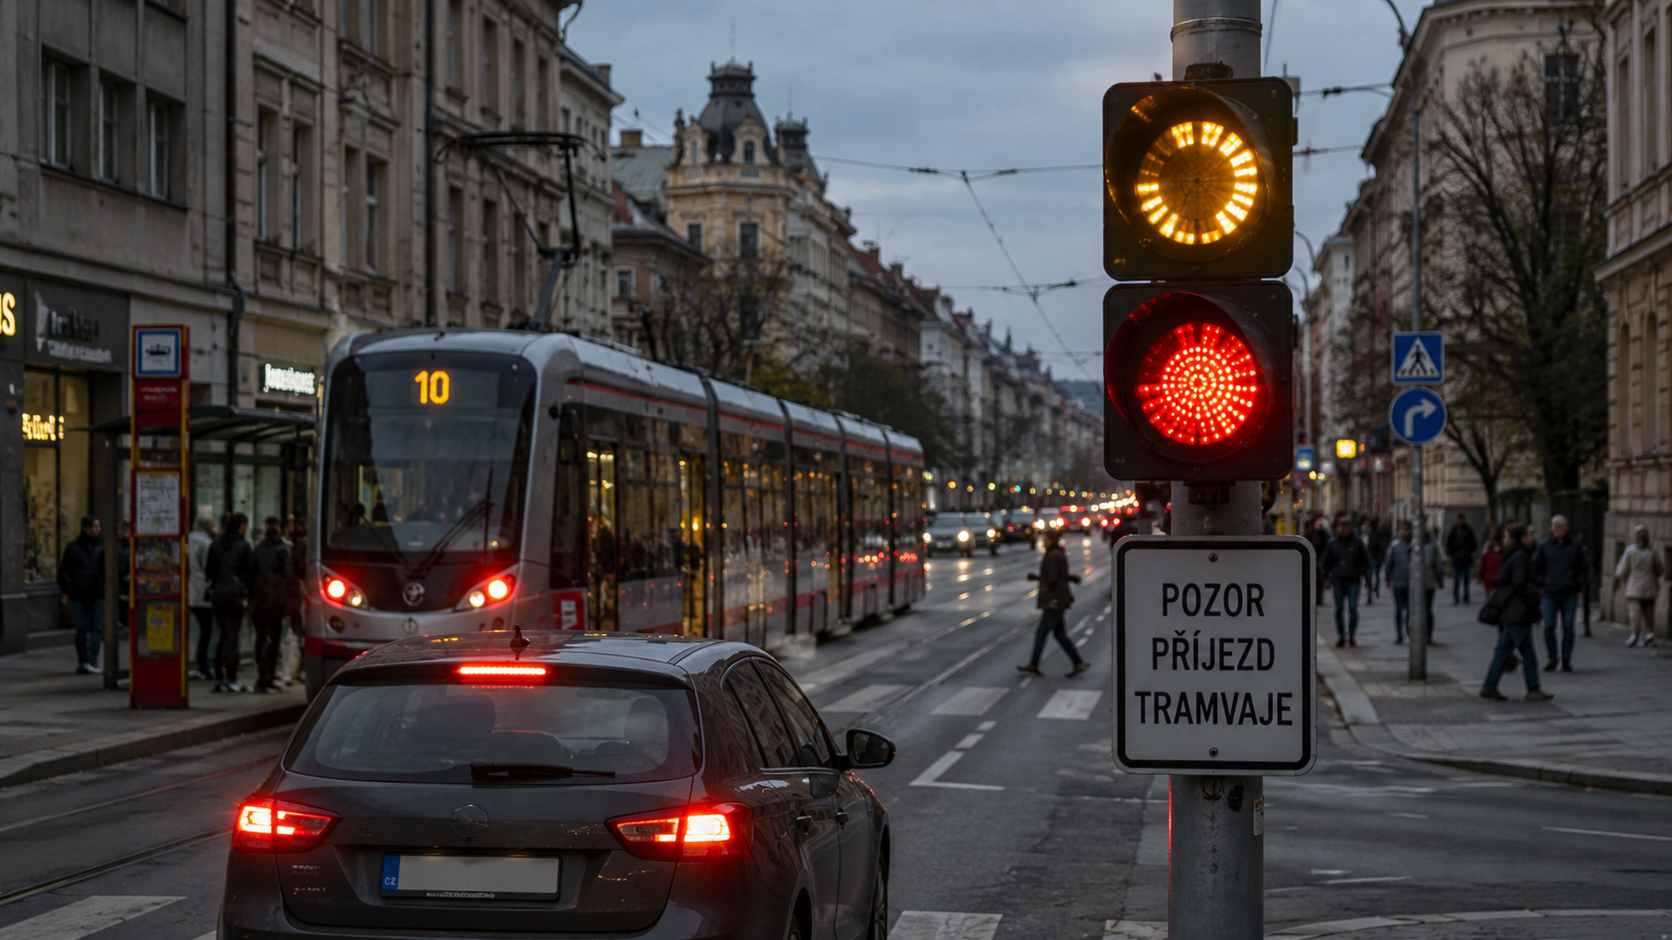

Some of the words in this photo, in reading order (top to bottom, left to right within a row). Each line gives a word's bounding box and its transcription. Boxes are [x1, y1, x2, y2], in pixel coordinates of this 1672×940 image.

[415, 370, 450, 404] 10
[1162, 583, 1265, 617] POZOR
[1152, 630, 1275, 671] PŘÍJEZD
[1134, 691, 1293, 726] TRAMVAJE
